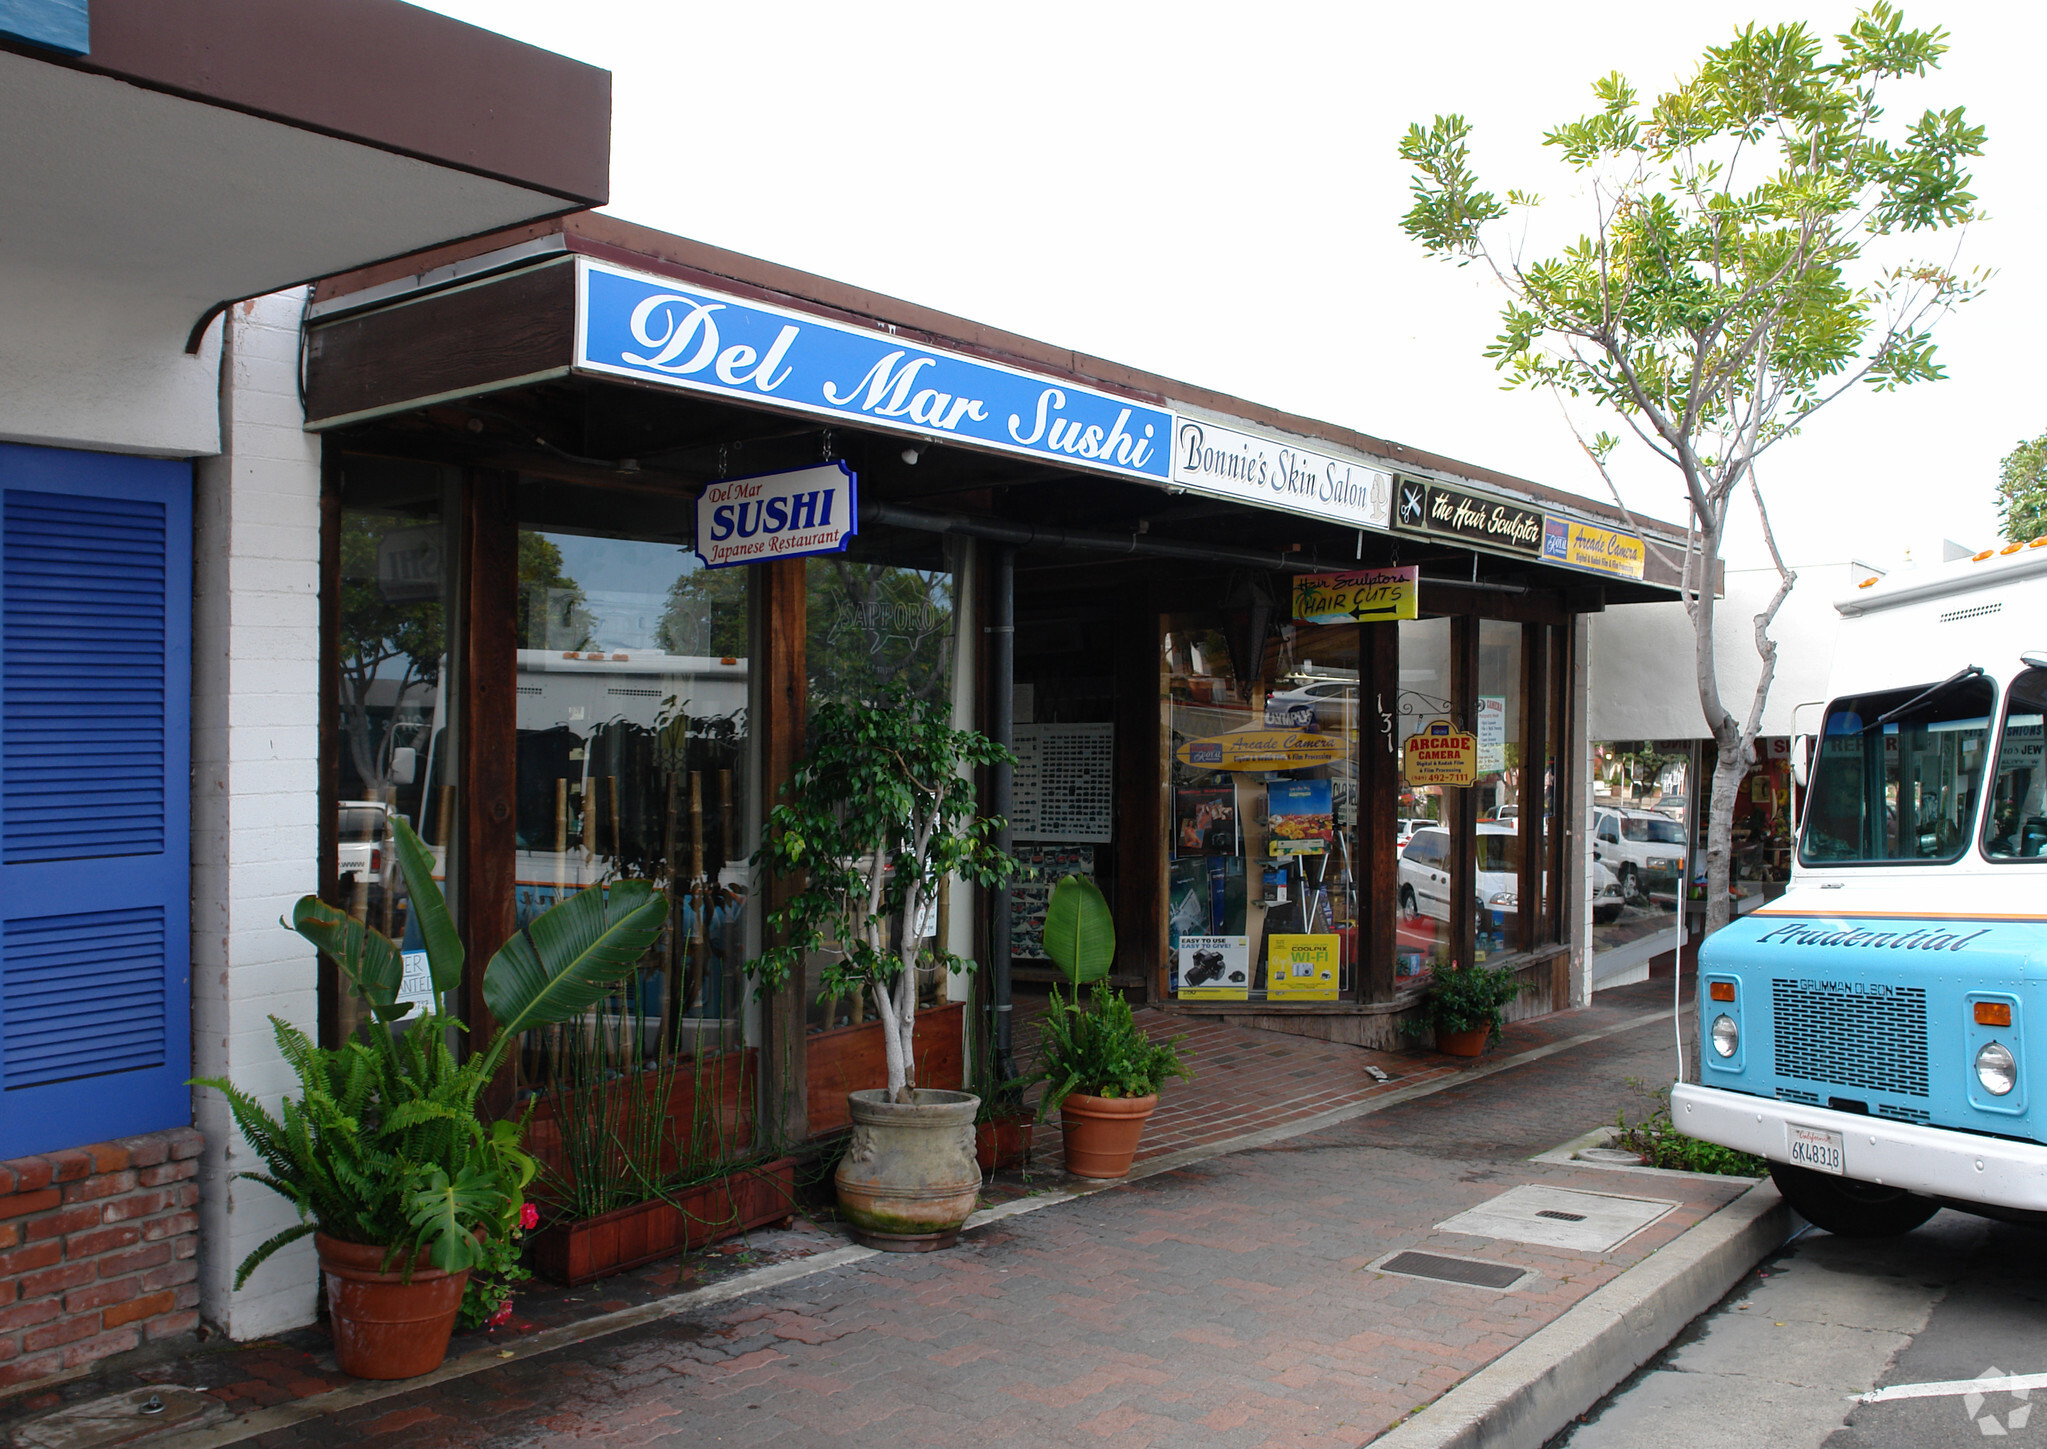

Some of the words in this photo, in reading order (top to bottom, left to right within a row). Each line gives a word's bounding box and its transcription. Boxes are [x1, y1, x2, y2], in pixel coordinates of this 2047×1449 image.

[621, 294, 800, 392] Del
[823, 351, 988, 431] Mar
[1008, 388, 1154, 468] Sushi
[1180, 423, 1267, 485] Bonnie's
[1271, 448, 1316, 496] Skin
[1319, 461, 1367, 508] Salon
[708, 484, 733, 502] Del
[735, 483, 763, 500] Mar
[711, 488, 836, 542] SUSHI
[1432, 492, 1452, 521] the
[1452, 498, 1486, 530] Hair
[1487, 506, 1540, 545] Sculptor
[711, 542, 764, 562] Japanese
[768, 529, 840, 552] Restaurant
[1573, 527, 1605, 552] Arcade
[1607, 534, 1637, 560] Camera
[1294, 577, 1330, 591] Hair
[1332, 573, 1410, 591] Sculptors
[1304, 594, 1345, 615] HAIR
[1353, 587, 1401, 605] CUTS
[841, 601, 935, 631] SAPPORO
[1230, 737, 1278, 751] Arcade
[1283, 734, 1335, 749] Camera
[1410, 737, 1470, 752] ARCADE
[1419, 750, 1461, 760] CAMERA
[1429, 774, 1468, 782] 492-7111
[1756, 923, 1992, 951] Prudential
[1291, 952, 1328, 962] WI-FI
[1800, 979, 1852, 992] GRUMMAN
[1855, 983, 1893, 996] OLSON
[1792, 1142, 1839, 1168] 6K48318
